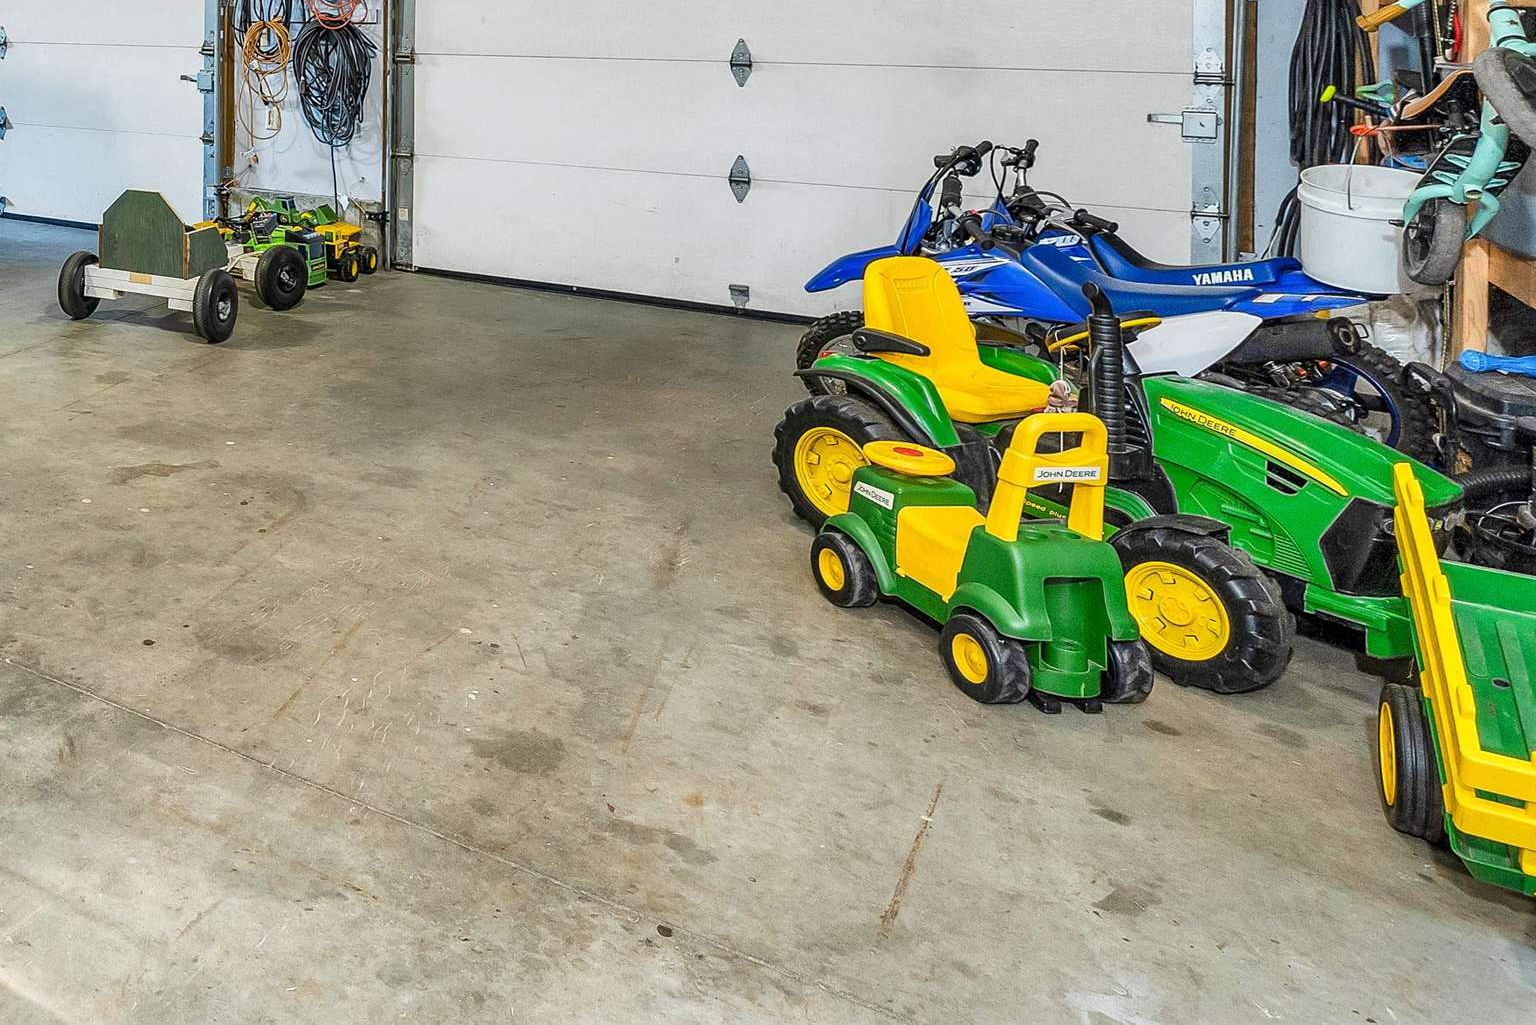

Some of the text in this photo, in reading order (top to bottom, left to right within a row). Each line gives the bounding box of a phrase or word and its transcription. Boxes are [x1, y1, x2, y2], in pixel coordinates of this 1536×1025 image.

[1192, 268, 1254, 287] YAMAHA
[1170, 403, 1238, 437] JOHN DEERE
[1036, 469, 1097, 479] JOHN DEERE
